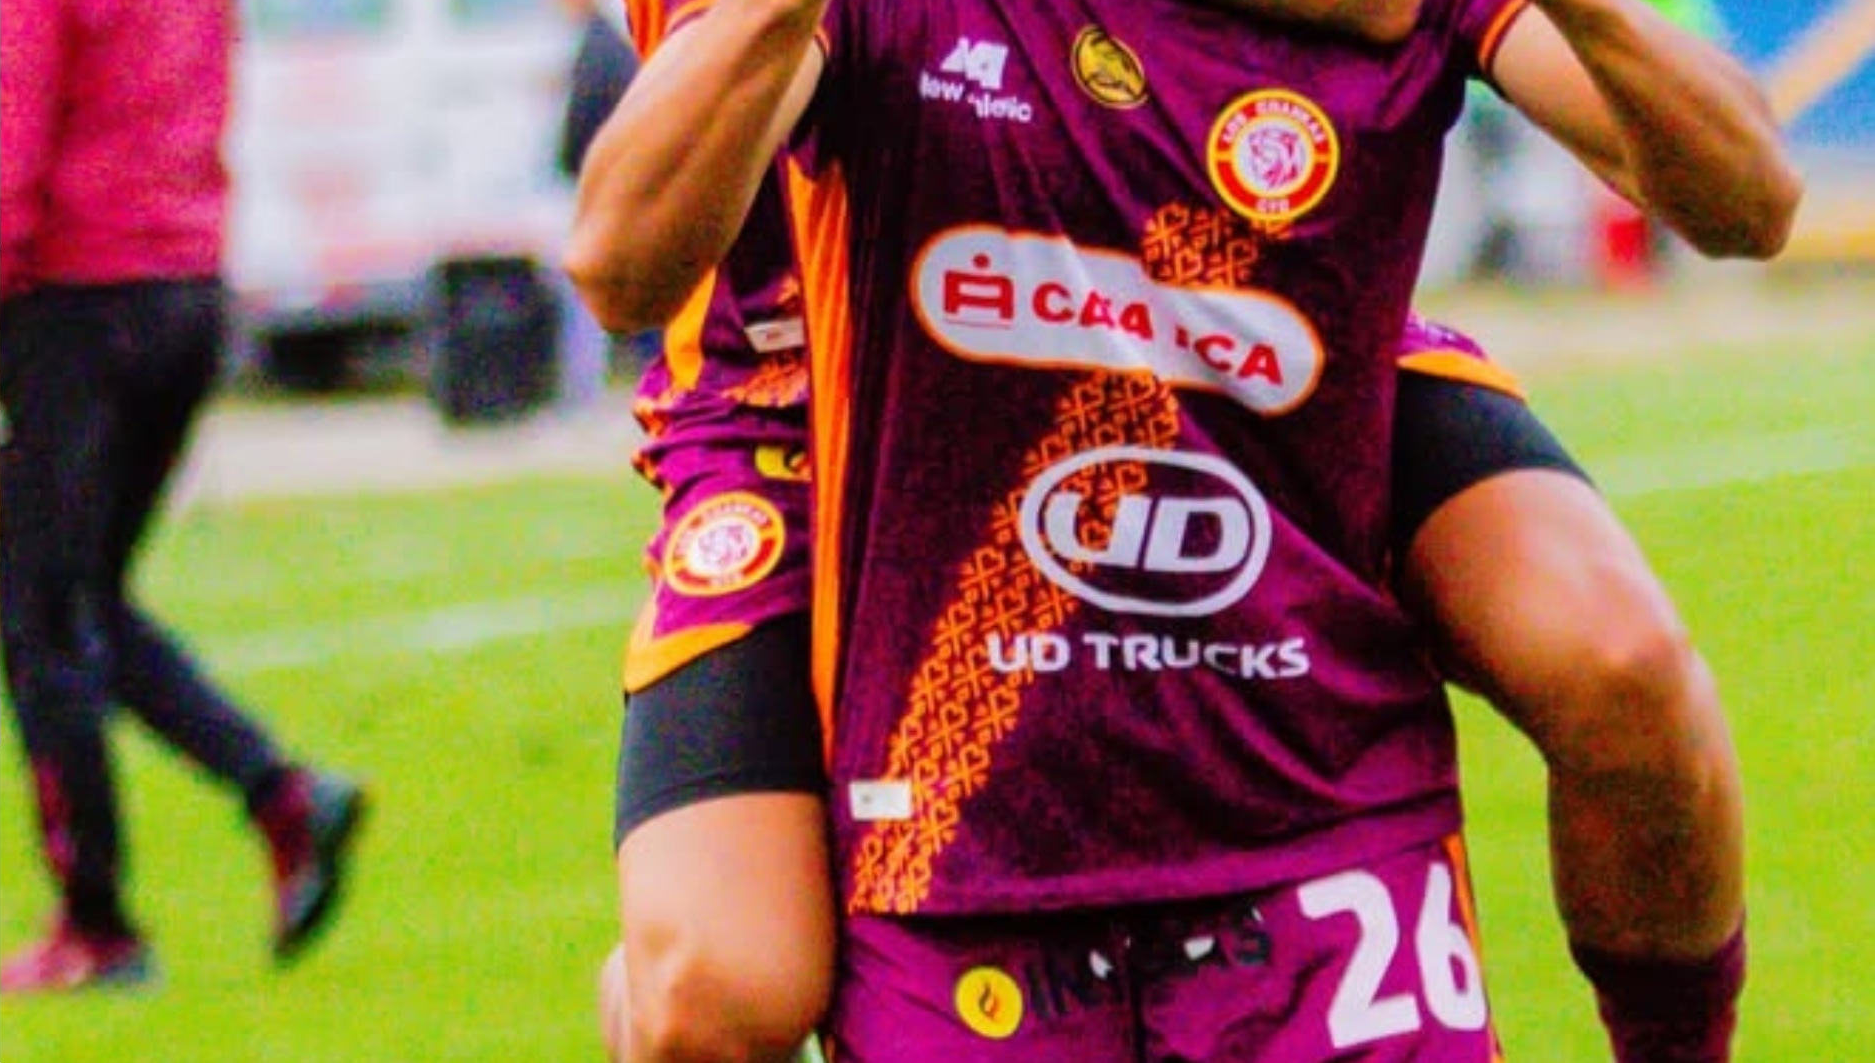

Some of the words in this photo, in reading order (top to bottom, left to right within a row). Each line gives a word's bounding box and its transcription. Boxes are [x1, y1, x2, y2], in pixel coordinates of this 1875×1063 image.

[1031, 281, 1154, 341] CAA
[1043, 490, 1254, 574] UD
[987, 631, 1071, 673] UD
[1082, 632, 1312, 681] TRUCKS
[1296, 861, 1489, 1050] 26
